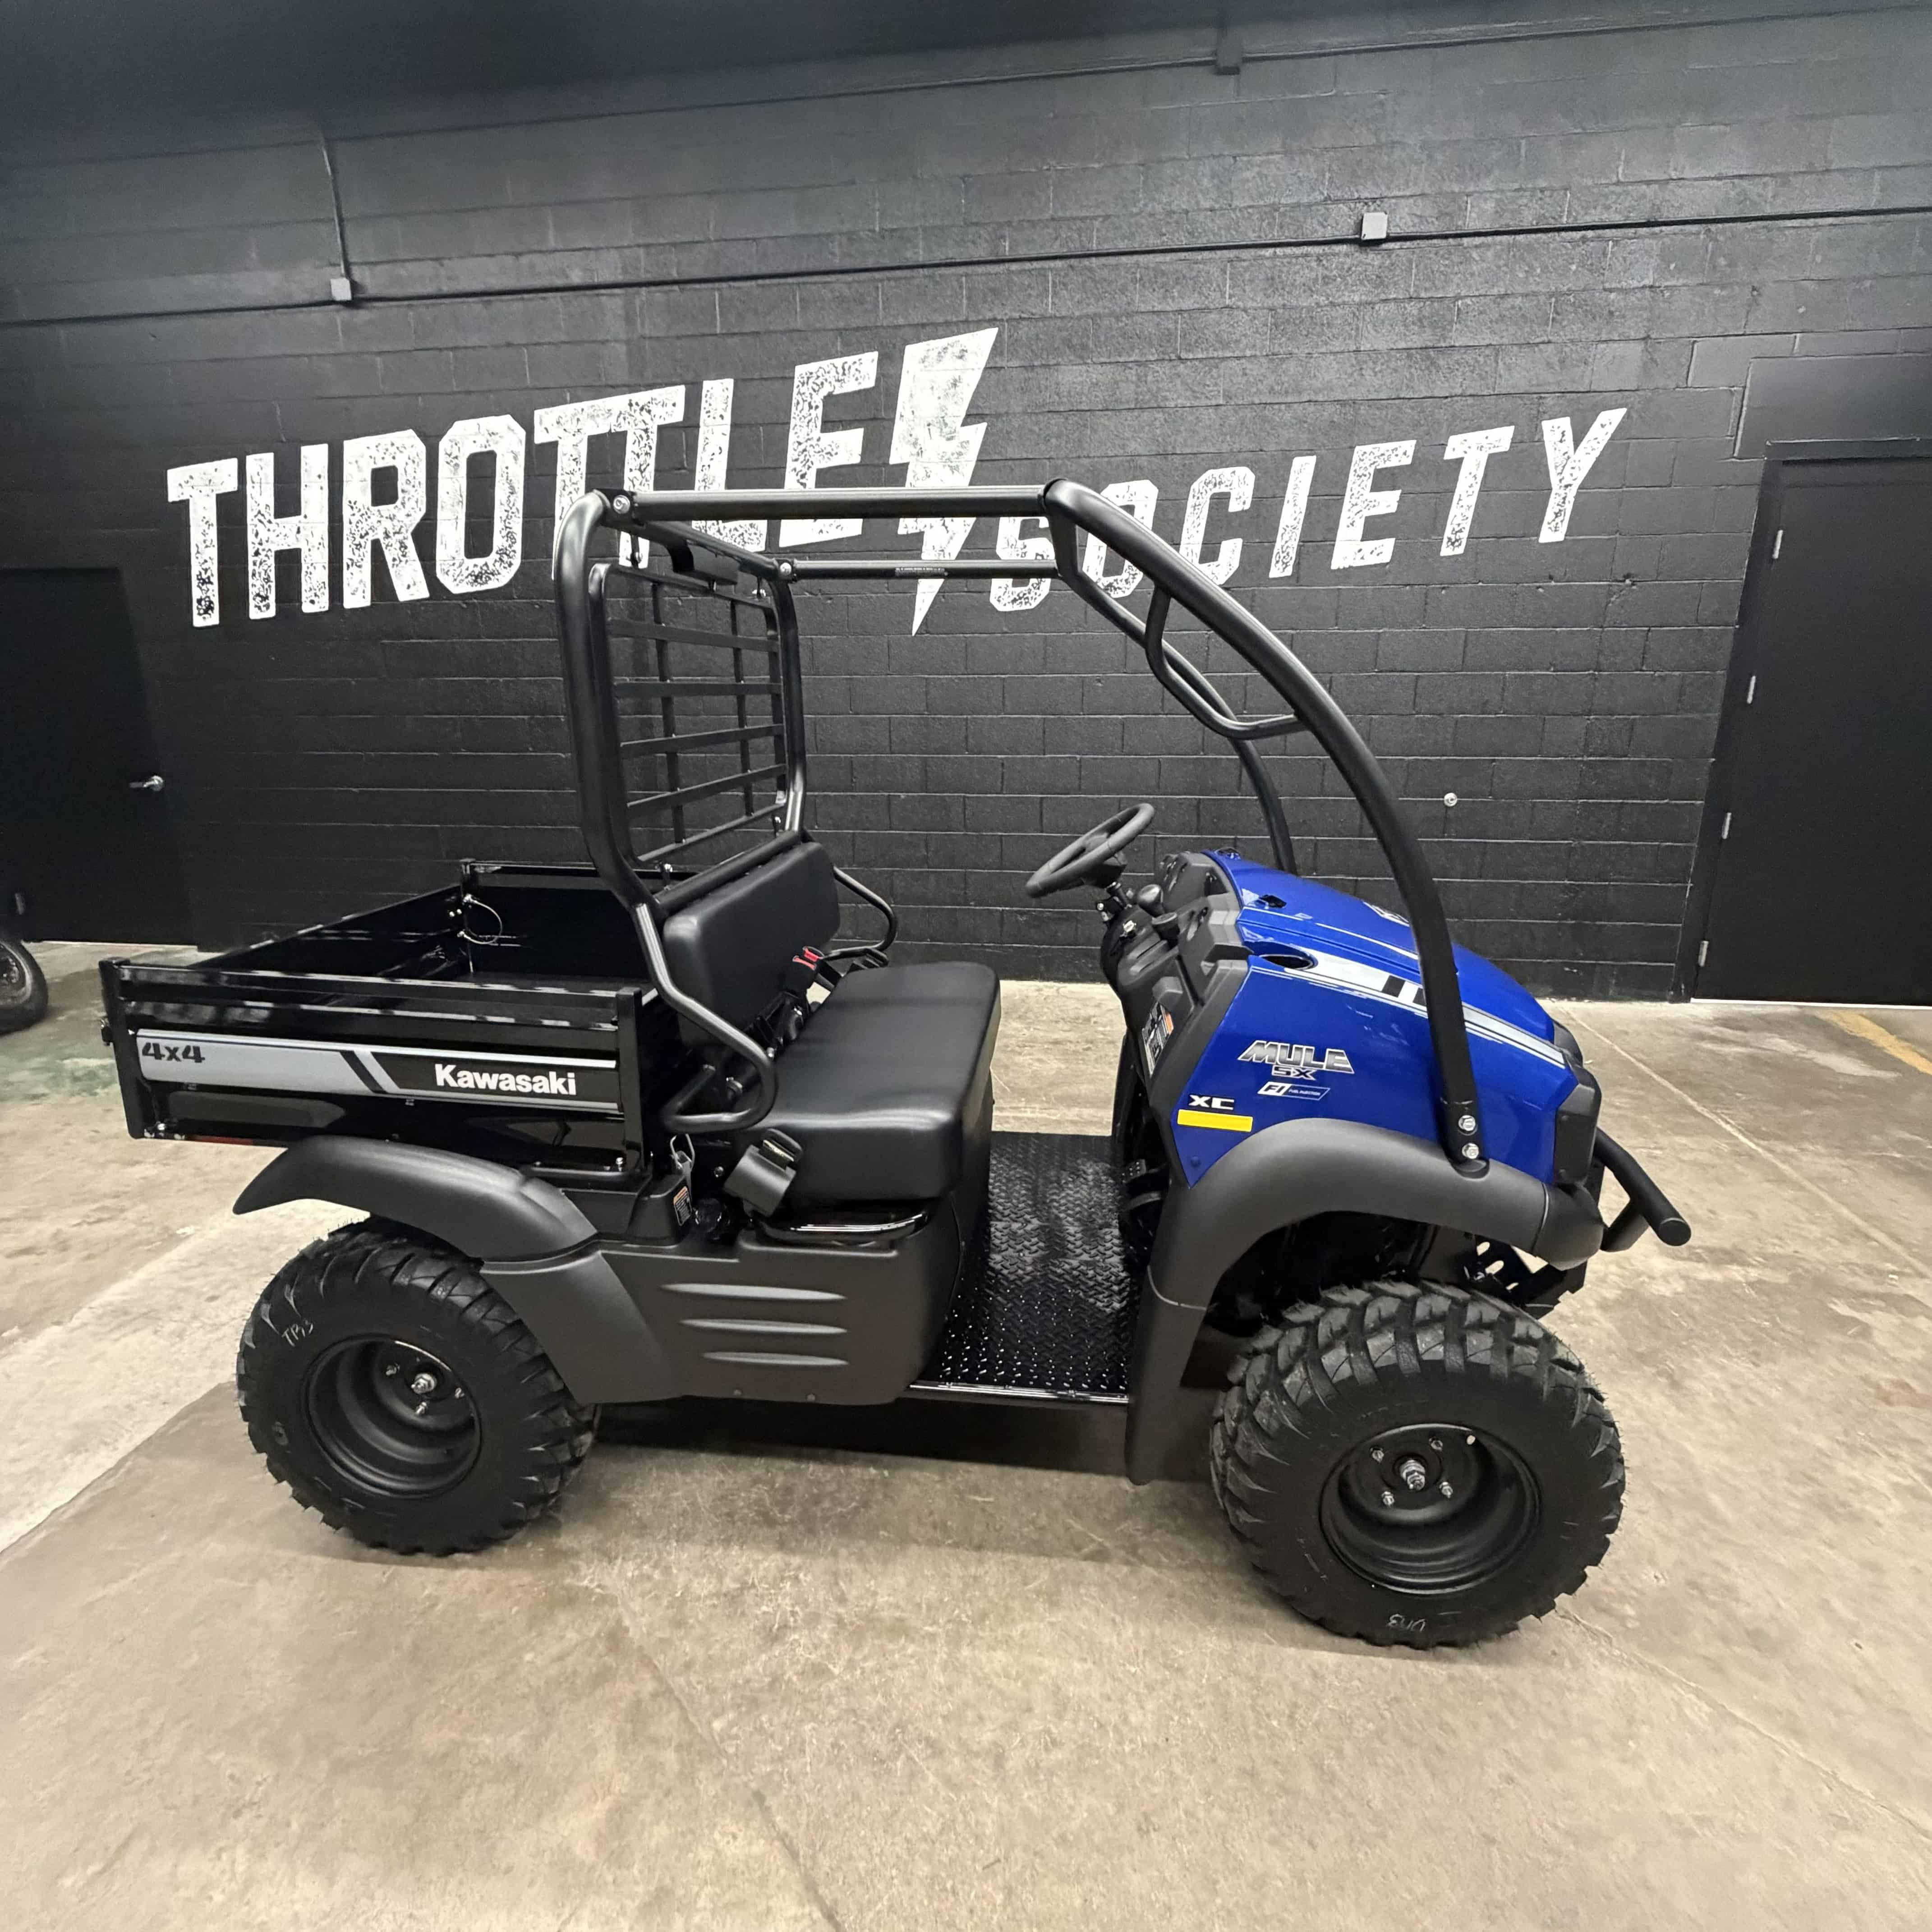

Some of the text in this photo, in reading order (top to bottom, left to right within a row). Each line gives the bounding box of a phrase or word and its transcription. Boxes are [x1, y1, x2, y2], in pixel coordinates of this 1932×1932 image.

[167, 350, 879, 627] THROTTLE
[989, 407, 1627, 612] SOCIETY
[142, 1042, 205, 1063] 4x4
[1237, 1040, 1355, 1074] MULE
[435, 1063, 576, 1095] Kawasaki
[1271, 1065, 1317, 1081] SX
[1263, 1085, 1286, 1093] FI
[1188, 1095, 1234, 1110] XC
